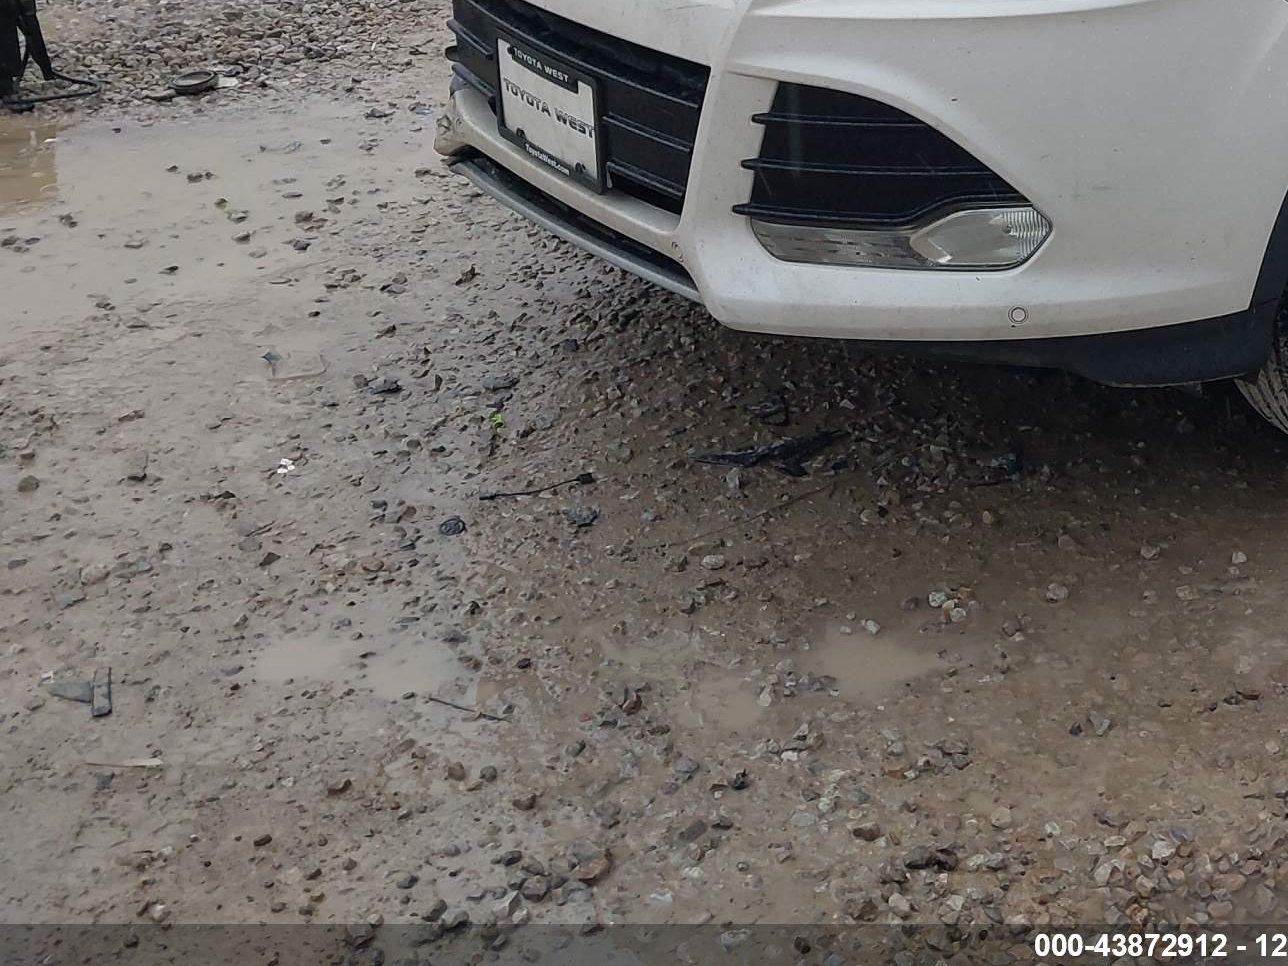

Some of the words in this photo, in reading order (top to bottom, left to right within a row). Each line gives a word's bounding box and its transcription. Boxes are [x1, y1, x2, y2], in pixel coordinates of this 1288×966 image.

[513, 47, 542, 70] TOYOTA
[544, 65, 569, 83] WEST
[503, 77, 551, 117] TOYOTA
[554, 107, 595, 139] WEST
